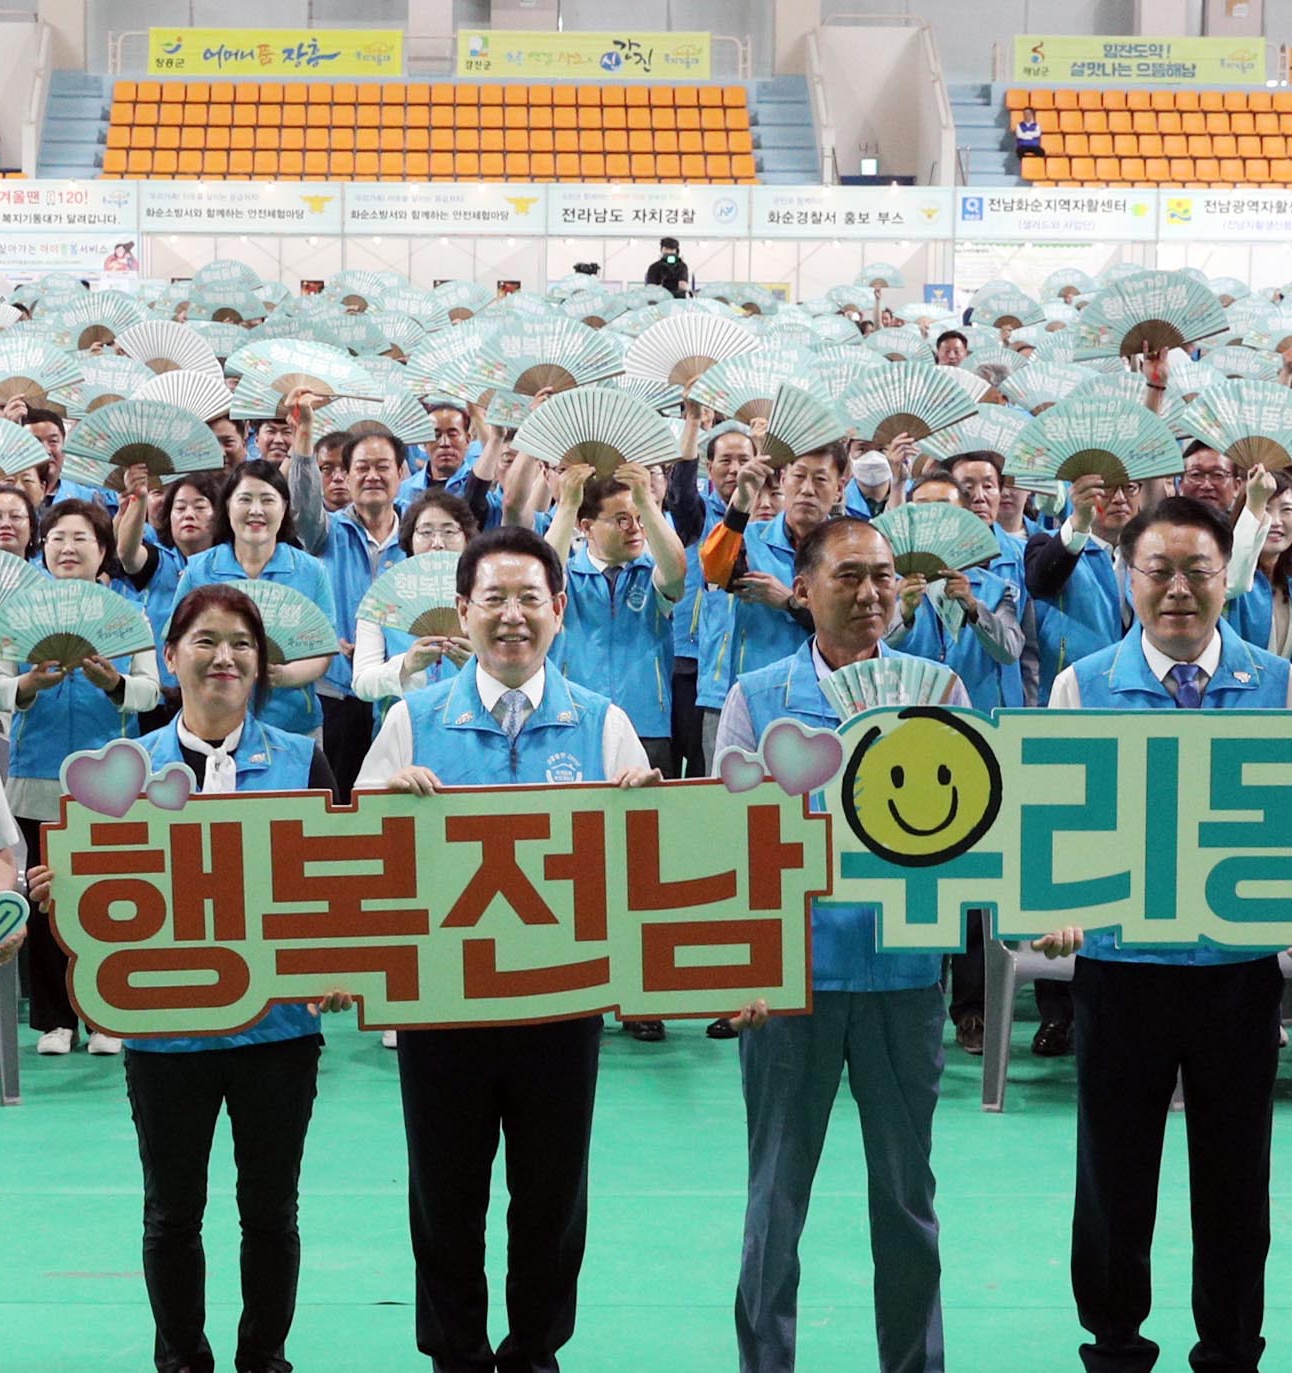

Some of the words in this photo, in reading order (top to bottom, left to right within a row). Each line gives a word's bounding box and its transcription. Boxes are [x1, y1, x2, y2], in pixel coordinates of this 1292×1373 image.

[988, 198, 1127, 213] 전남화순지역자활센터
[2, 212, 63, 225] 복지기동대가
[67, 213, 121, 225] 달려갑니다.
[146, 207, 203, 219] 화순소방서와
[207, 207, 244, 219] 함께하는
[248, 208, 304, 220] 안전체험마당
[351, 209, 408, 220] 화순소방서와
[412, 209, 448, 221] 함께하는
[452, 210, 509, 222] 안전체험마당
[562, 207, 625, 224] 전라남도
[632, 208, 696, 225] 자치경찰
[767, 210, 837, 225] 화순경찰서
[844, 210, 871, 225] 홍보
[877, 211, 905, 225] 부스
[71, 805, 805, 1010] 행복전남
